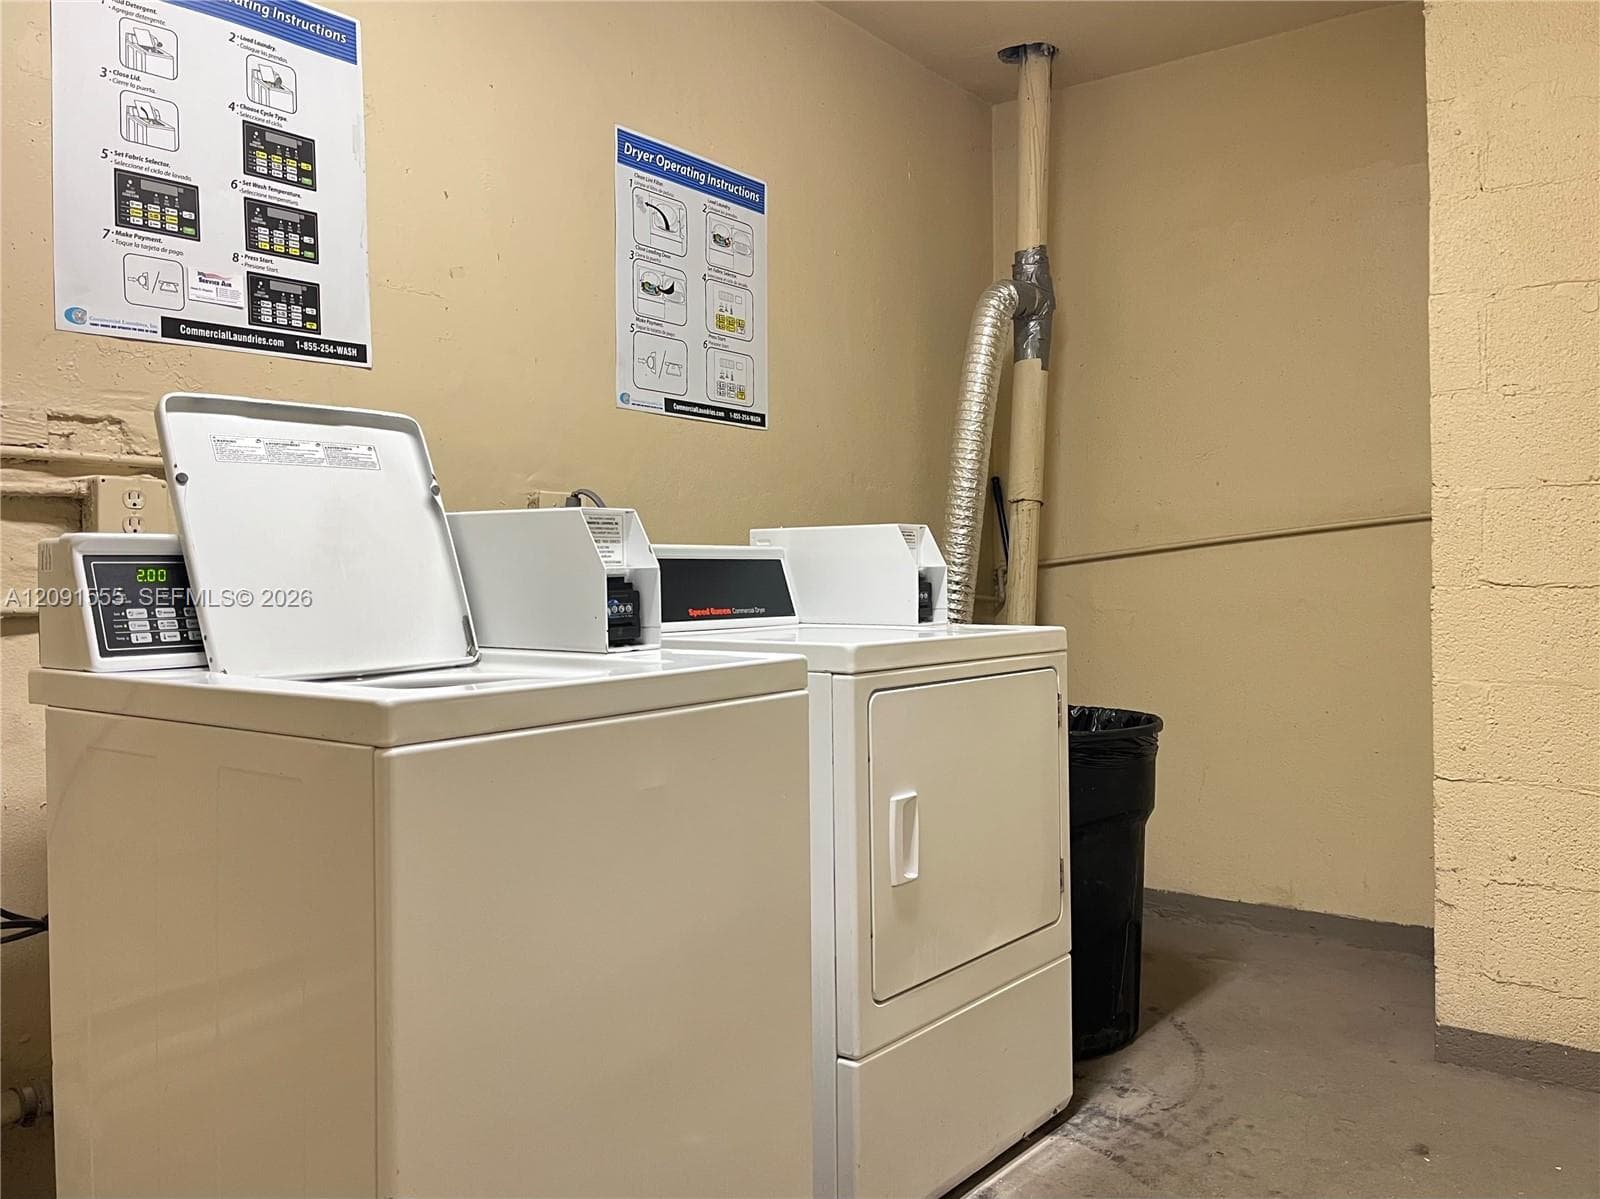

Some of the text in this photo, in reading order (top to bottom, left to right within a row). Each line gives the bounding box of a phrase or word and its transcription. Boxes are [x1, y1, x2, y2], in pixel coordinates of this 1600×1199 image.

[112, 6, 134, 16] Agregar
[126, 1, 157, 14] Detergent.
[272, 6, 346, 43] Instructions
[228, 32, 236, 42] 2
[240, 35, 254, 44] Load
[100, 67, 107, 78] 3
[113, 69, 129, 78] Close
[112, 78, 129, 86] Cierre
[228, 102, 235, 111] 4
[240, 104, 288, 122] Choose Cycle Type.
[240, 112, 265, 123] Seleccione
[100, 149, 109, 159] 5
[114, 160, 144, 170] Seleccione
[125, 153, 143, 161] Fabric
[145, 158, 170, 168] Selector.
[624, 142, 654, 162] Dryer
[656, 154, 706, 184] Operating
[707, 174, 760, 202] Instructions
[231, 179, 237, 189] 6
[629, 178, 633, 187] 1
[268, 186, 302, 198] Temperature.
[702, 203, 707, 213] 2
[102, 228, 110, 239] 7
[115, 230, 163, 243] Make Payment.
[115, 239, 133, 248] Toque
[140, 243, 160, 252] tarjeta
[232, 253, 239, 262] 8
[629, 250, 634, 259] 3
[702, 273, 706, 281] 4
[630, 323, 635, 332] 5
[180, 324, 284, 347] CommercialLaundries.com
[296, 340, 357, 357] 1-855-254-WASH
[703, 340, 707, 348] 6
[136, 569, 166, 582] 2.00
[688, 608, 710, 617] Speed
